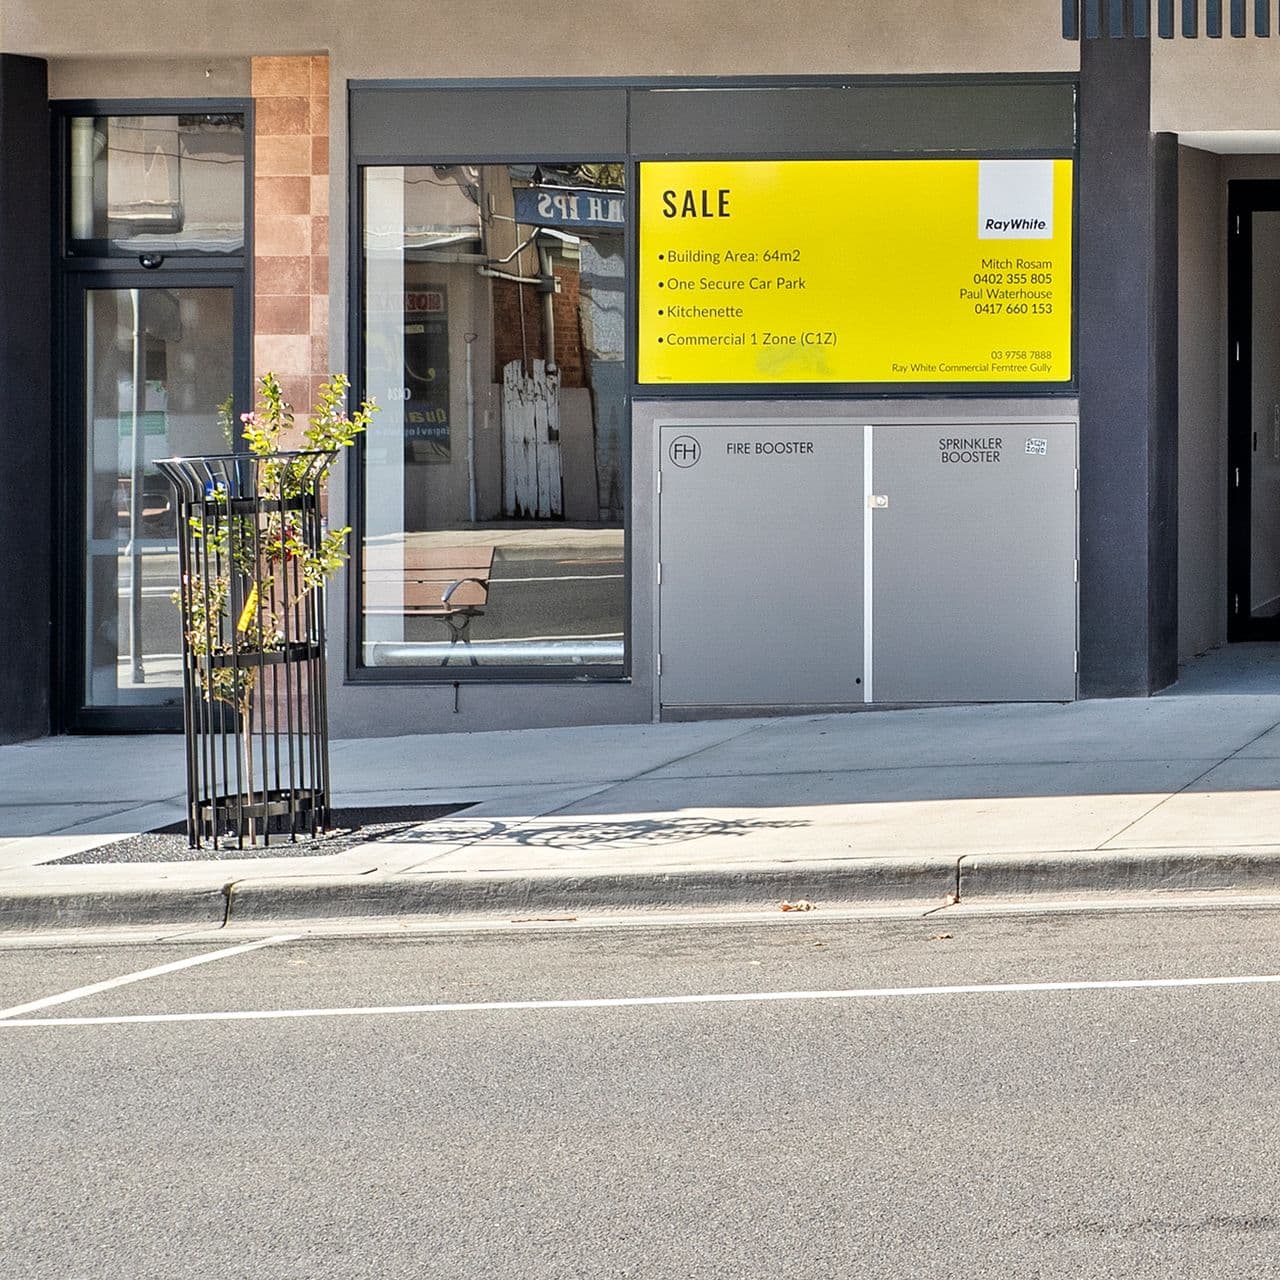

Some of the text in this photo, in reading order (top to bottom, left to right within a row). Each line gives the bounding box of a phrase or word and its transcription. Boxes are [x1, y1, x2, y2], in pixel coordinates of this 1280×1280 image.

[662, 189, 731, 218] SALE
[667, 250, 801, 264] Building Area: 64m2
[981, 258, 1052, 270] Mitch Rosam
[667, 277, 806, 289] One Secure Car Park
[973, 273, 1052, 284] 0402 355 805
[960, 288, 1052, 300] Paul Waterhouse
[667, 306, 743, 318] Kitchenette
[974, 303, 1052, 314] 0417 660 153
[667, 331, 837, 346] Commercial 1 Zone (C1Z)
[991, 350, 1052, 360] 03 9758 7888
[892, 362, 1052, 375] Ray White Commercial Ferntree Gully
[726, 442, 815, 455] FIRE BOOSTER
[938, 437, 1003, 450] SPRINKLER
[673, 442, 696, 460] FH
[941, 450, 1001, 464] BOOSTER
